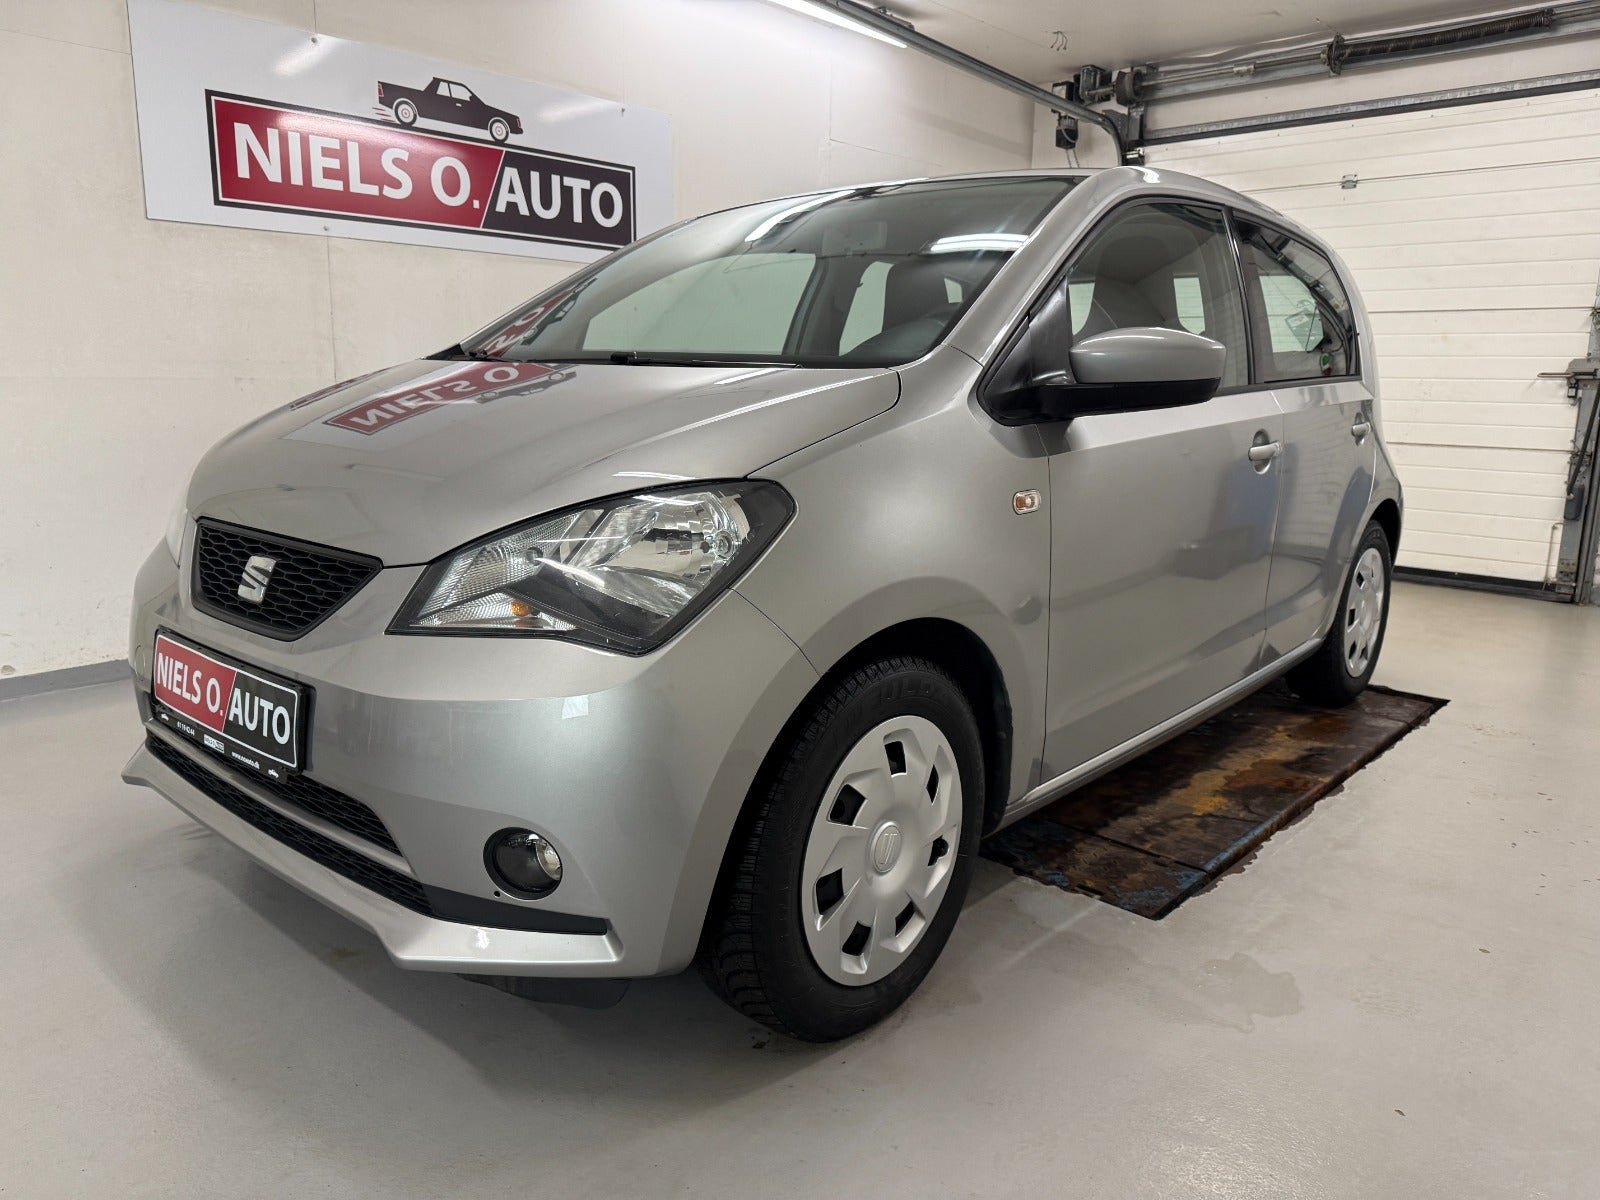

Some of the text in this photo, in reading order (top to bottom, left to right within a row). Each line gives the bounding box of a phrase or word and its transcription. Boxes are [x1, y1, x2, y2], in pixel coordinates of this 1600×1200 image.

[233, 122, 624, 229] NIELS O. AUTO
[157, 652, 290, 745] NIELS O. AUTO
